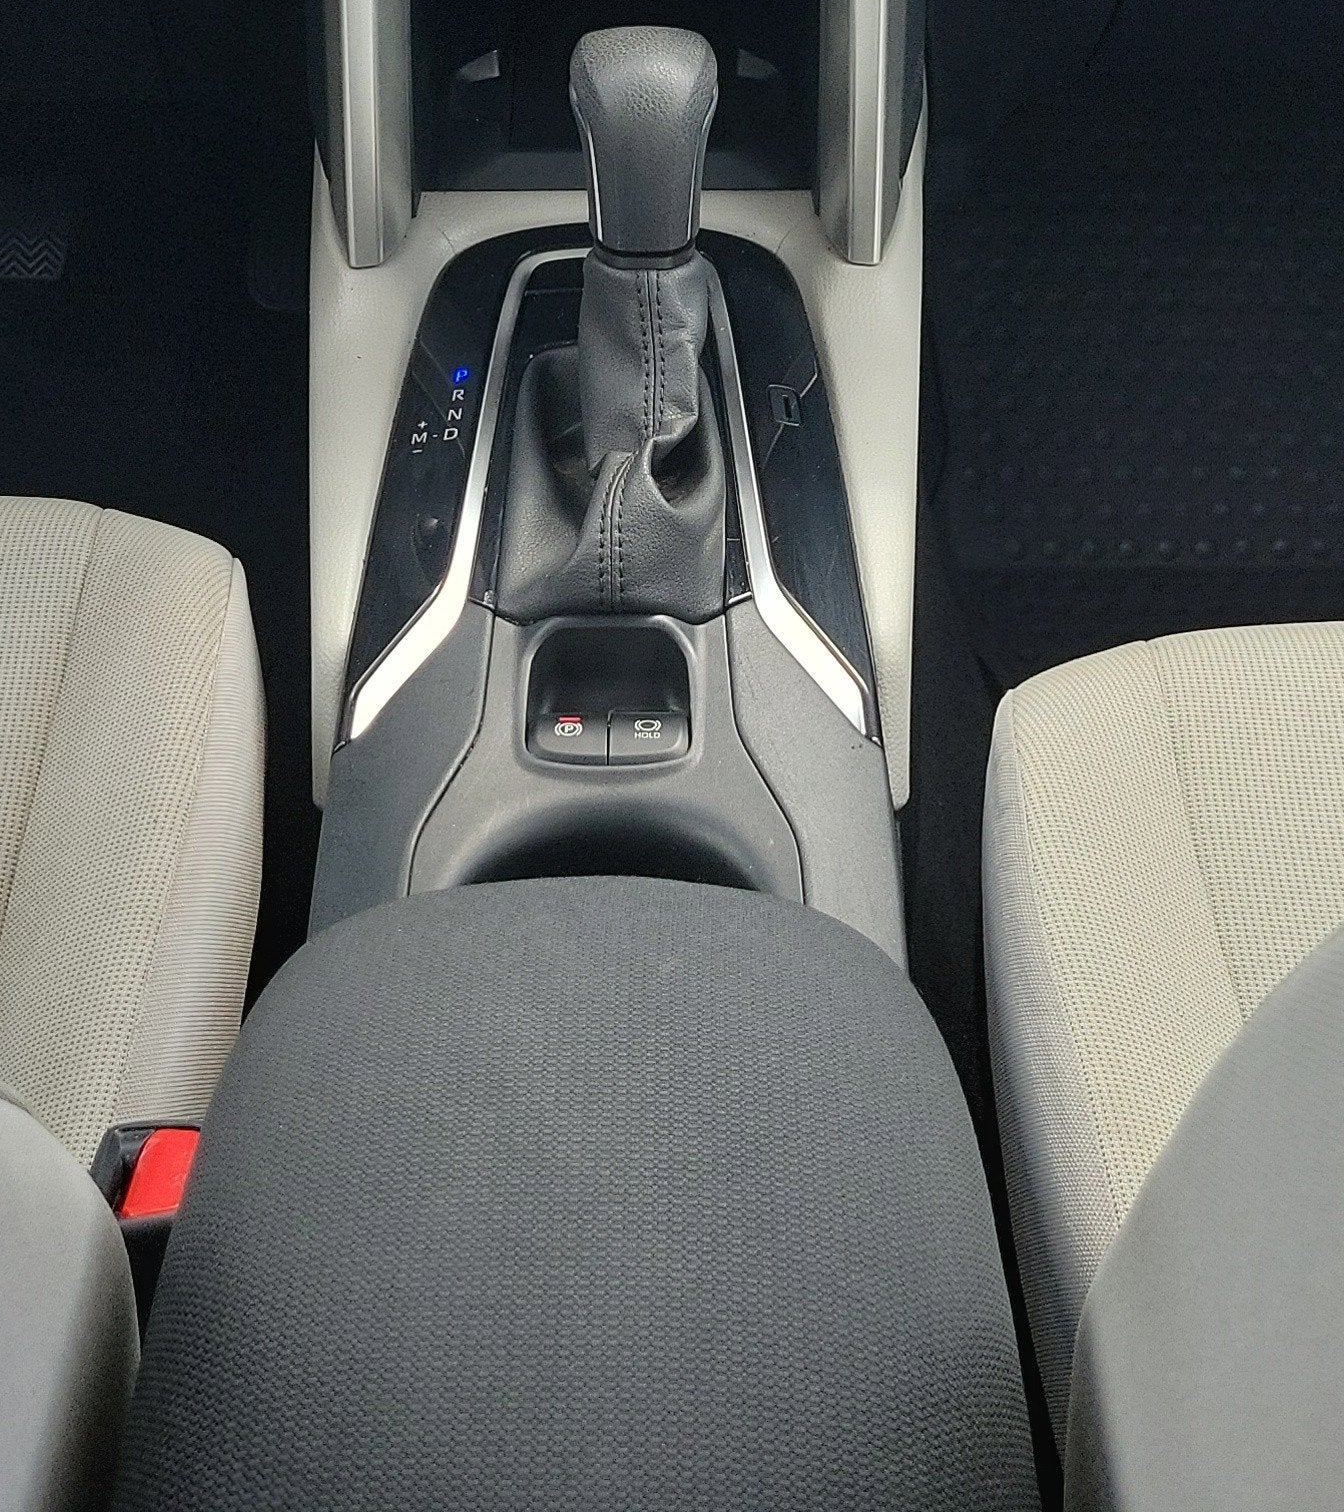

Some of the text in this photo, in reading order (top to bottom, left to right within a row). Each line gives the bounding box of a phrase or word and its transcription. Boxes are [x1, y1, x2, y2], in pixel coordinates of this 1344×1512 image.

[455, 369, 468, 383] P
[452, 389, 464, 402] R
[447, 407, 463, 421] N
[411, 427, 459, 445] M D
[634, 731, 661, 739] HOLD
